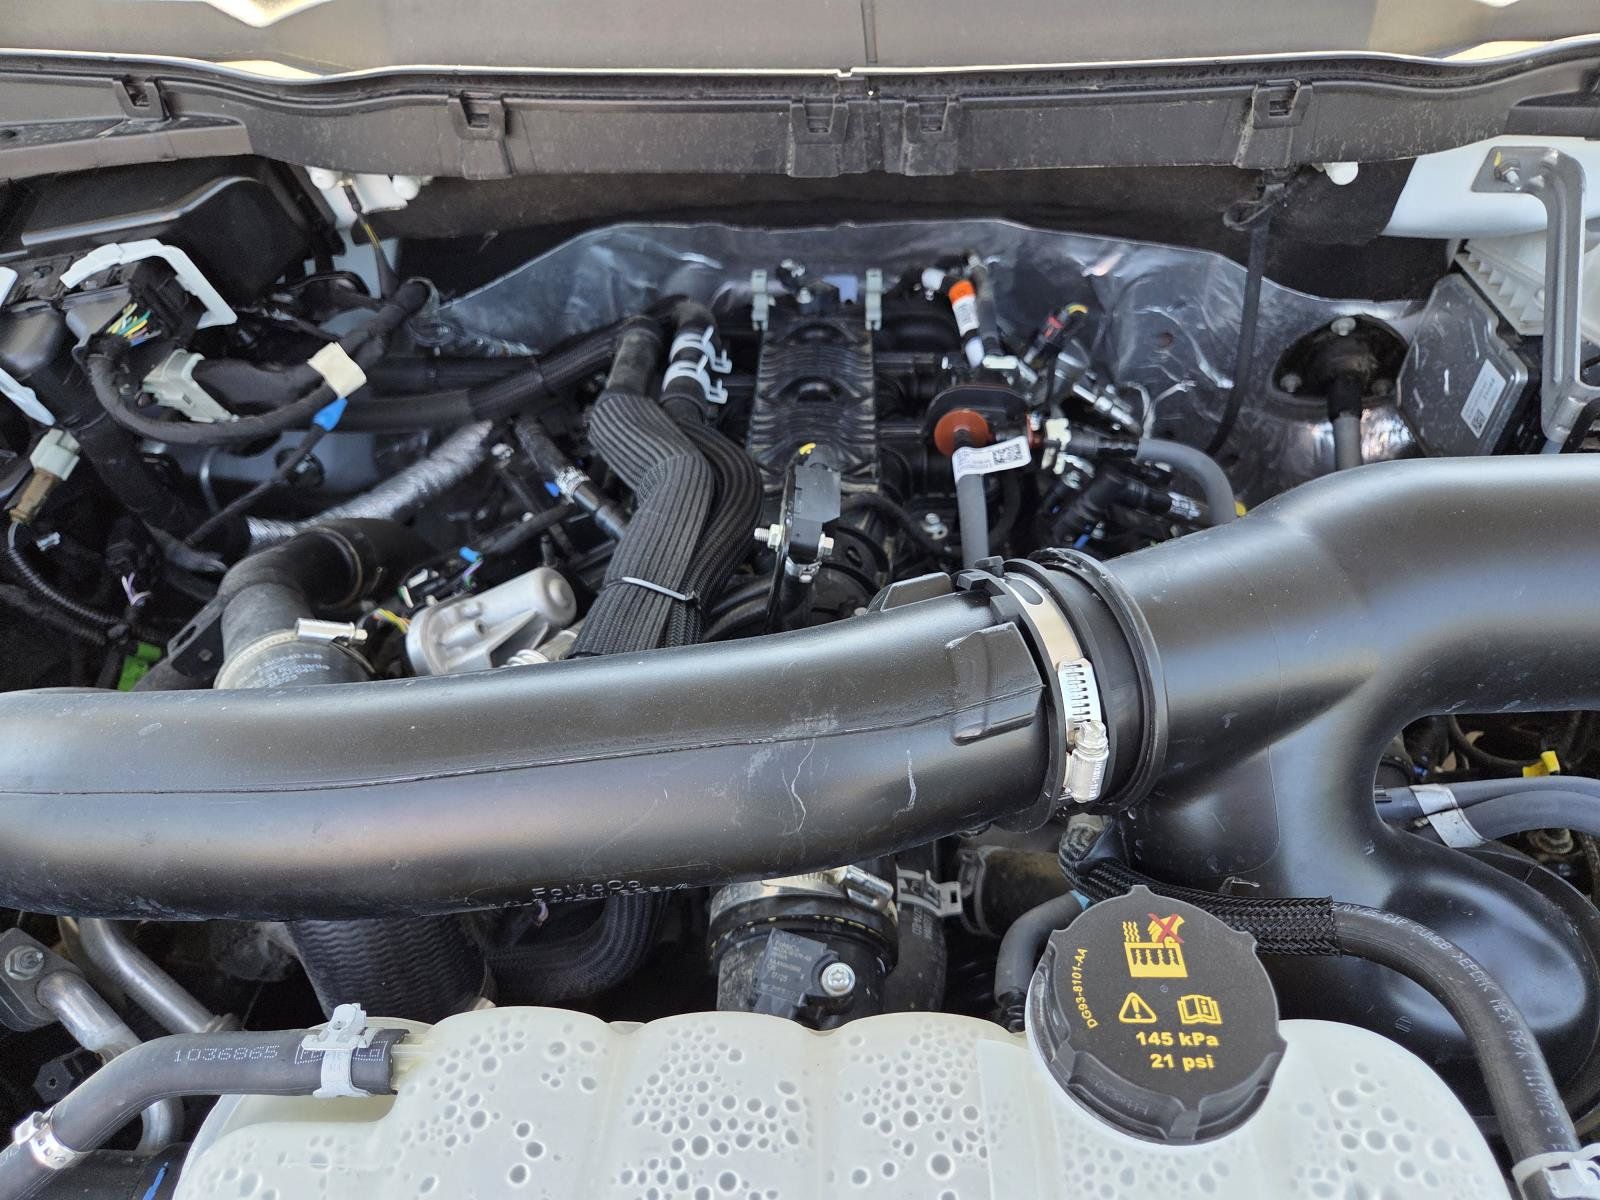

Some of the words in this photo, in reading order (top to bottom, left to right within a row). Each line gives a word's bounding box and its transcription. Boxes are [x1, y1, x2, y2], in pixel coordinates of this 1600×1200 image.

[1071, 947, 1099, 1030] DG93-8101-AA
[1135, 1032, 1173, 1046] 145
[1179, 1032, 1220, 1047] kPa
[174, 1045, 280, 1064] 1036865
[1151, 1054, 1174, 1069] 21
[1183, 1054, 1215, 1072] psi
